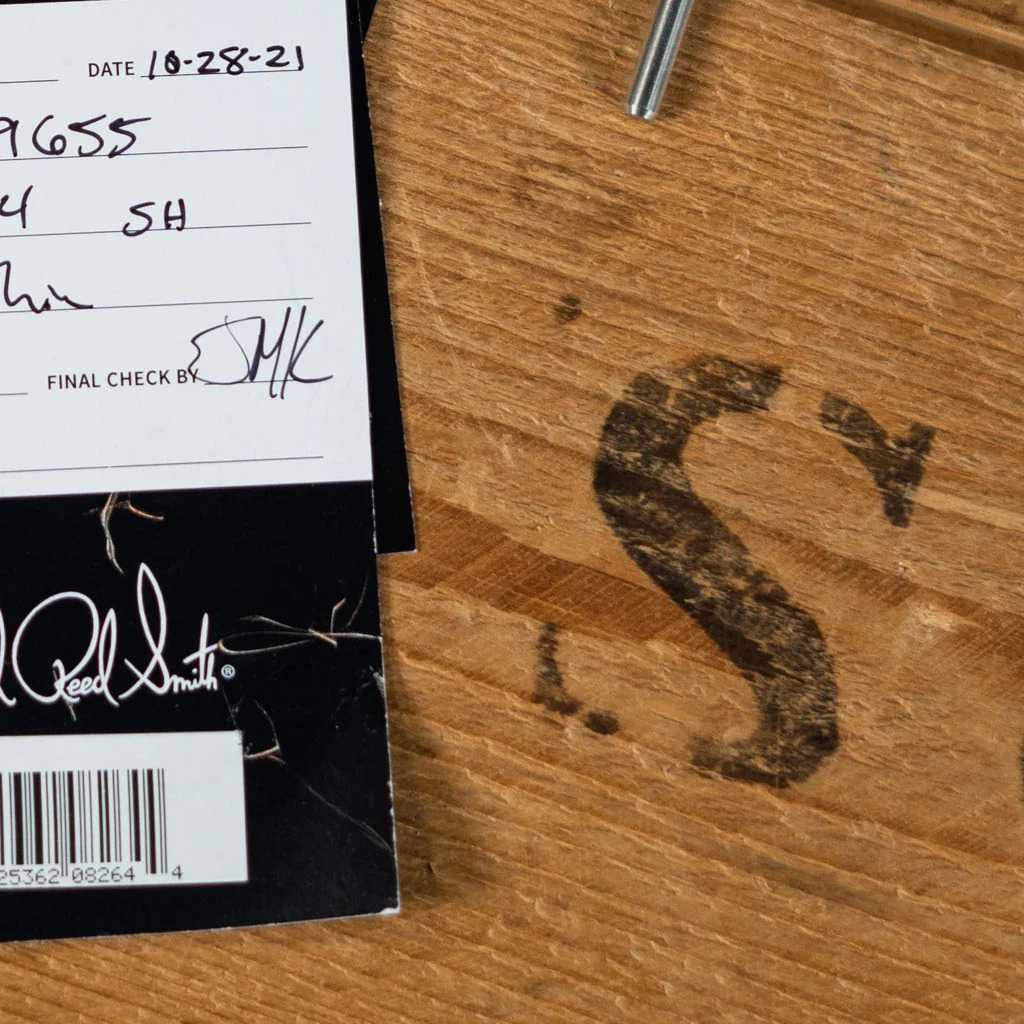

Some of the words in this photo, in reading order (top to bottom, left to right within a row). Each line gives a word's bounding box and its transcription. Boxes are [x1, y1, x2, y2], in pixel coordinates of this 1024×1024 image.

[88, 61, 135, 77] DATE
[147, 45, 305, 80] 10-28-21
[46, 373, 102, 390] FINAL
[107, 370, 171, 389] CHECK
[177, 368, 199, 385] BY
[11, 590, 120, 707] Reed
[71, 865, 136, 884] 08264
[171, 864, 184, 879] 4
